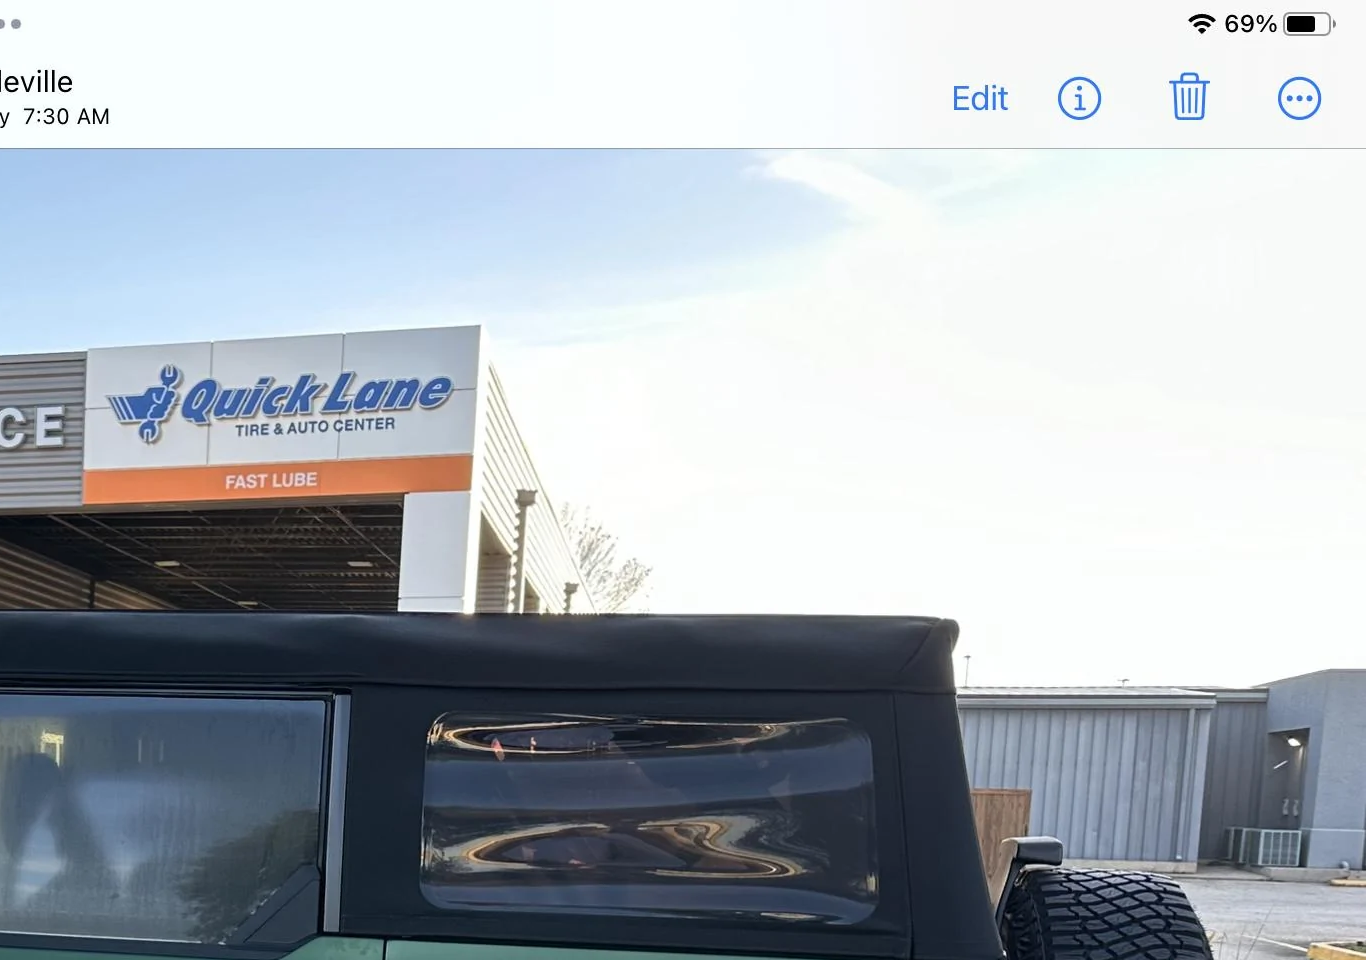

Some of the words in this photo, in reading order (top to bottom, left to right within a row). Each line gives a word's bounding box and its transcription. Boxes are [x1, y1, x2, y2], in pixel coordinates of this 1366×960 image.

[181, 371, 328, 425] Quick
[319, 370, 455, 414] Lane
[235, 423, 270, 437] TIRE
[273, 422, 285, 436] &
[287, 420, 330, 434] AUTO
[333, 417, 396, 432] CENTER
[225, 473, 268, 490] FAST
[273, 471, 319, 488] LUBE
